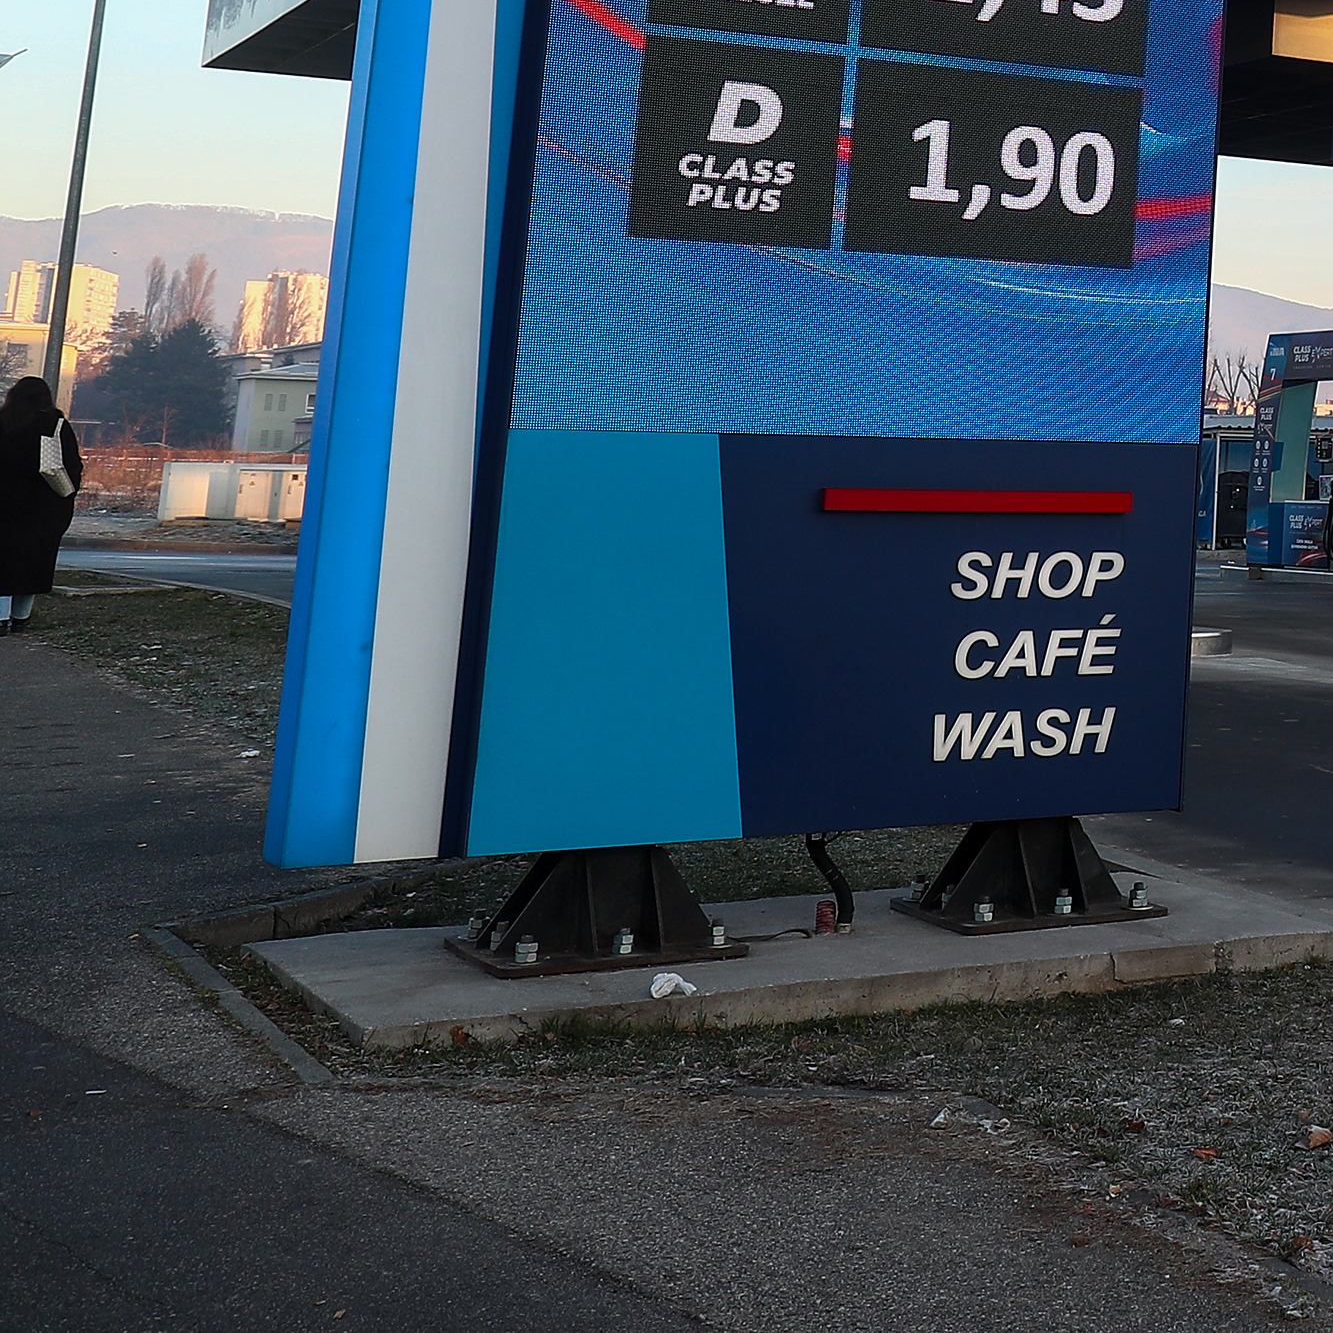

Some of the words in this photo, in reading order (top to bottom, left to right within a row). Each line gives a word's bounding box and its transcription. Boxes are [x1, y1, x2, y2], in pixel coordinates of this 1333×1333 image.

[706, 79, 784, 146] D
[907, 118, 1116, 222] 1,90
[677, 152, 796, 186] CLASS
[685, 182, 782, 213] PLUS
[1293, 345, 1311, 354] CLASS
[1294, 354, 1309, 362] PLUS
[1270, 368, 1276, 381] 7
[950, 551, 1126, 600] SHOP
[953, 613, 1122, 680] CAFÉ
[932, 706, 1118, 762] WASH
